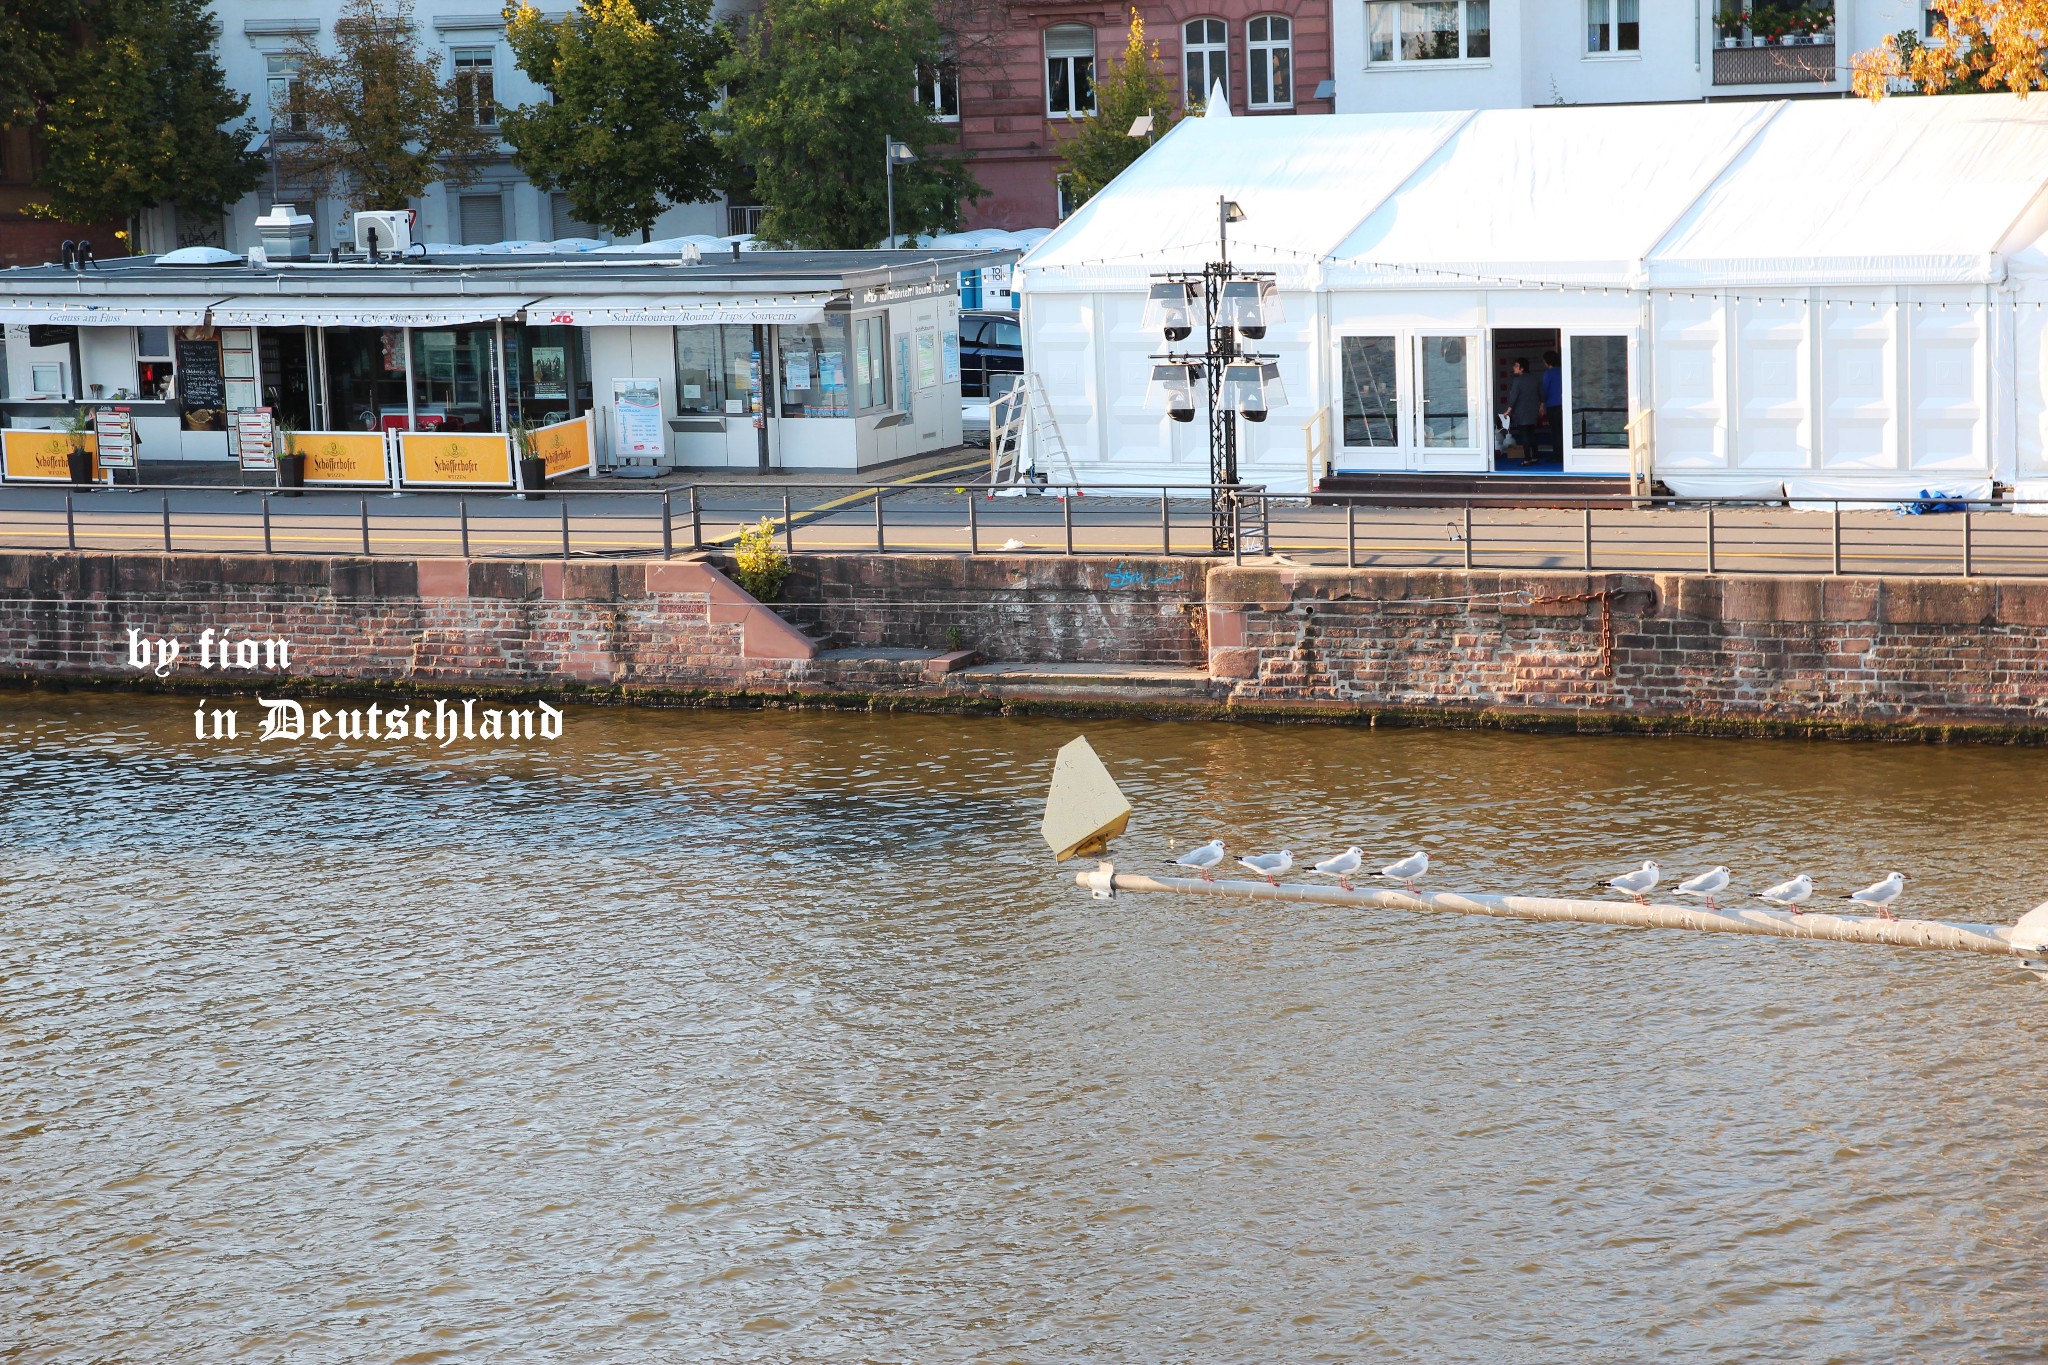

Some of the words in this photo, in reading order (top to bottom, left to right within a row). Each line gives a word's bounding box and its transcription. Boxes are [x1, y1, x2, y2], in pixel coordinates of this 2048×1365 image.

[49, 313, 80, 322] Genuss
[83, 315, 97, 323] am
[100, 313, 122, 323] Fluss
[314, 454, 356, 472] Schöfferhofer
[434, 456, 478, 474] Schöfferhofer
